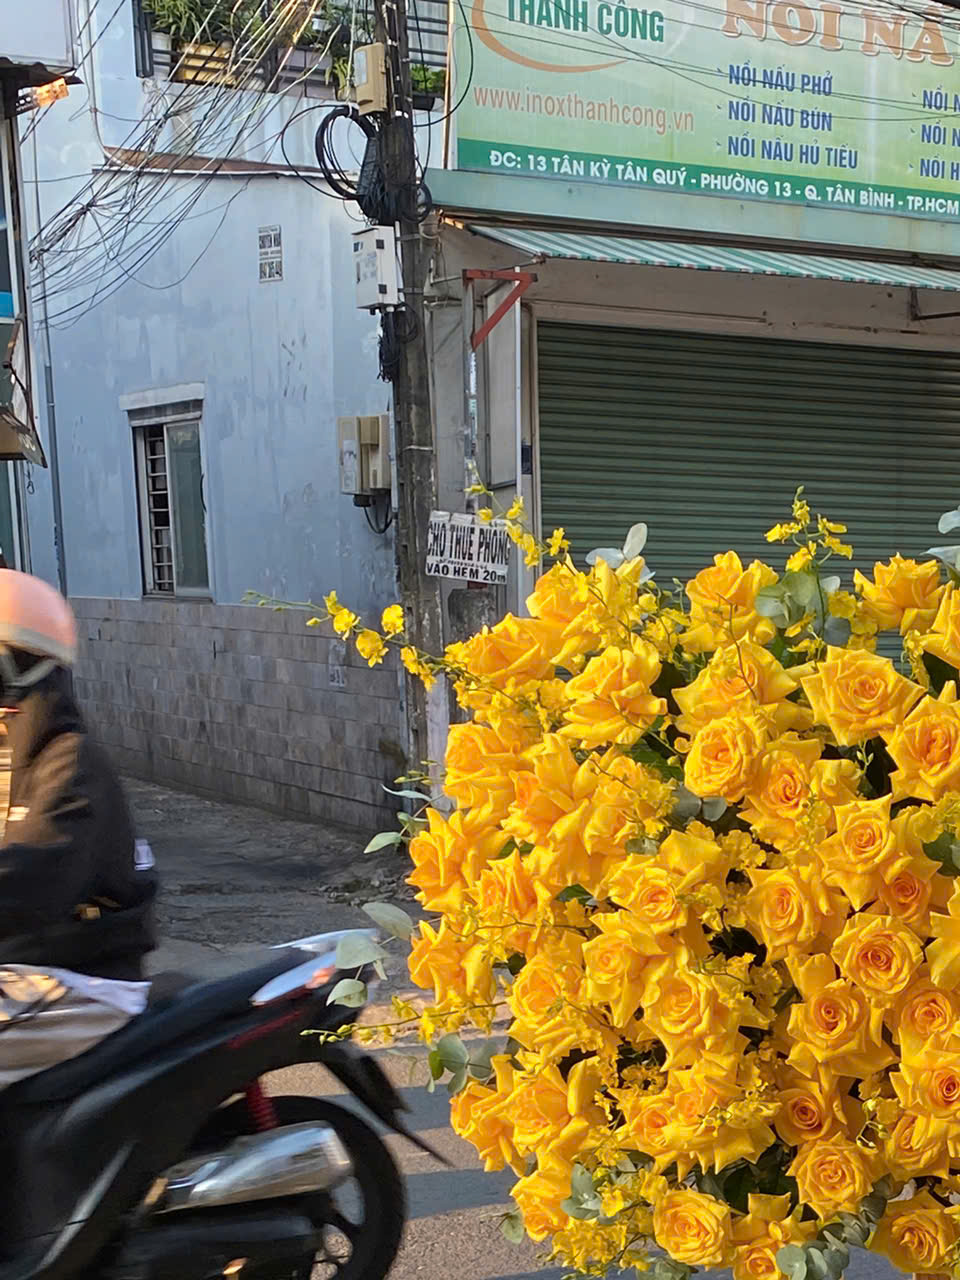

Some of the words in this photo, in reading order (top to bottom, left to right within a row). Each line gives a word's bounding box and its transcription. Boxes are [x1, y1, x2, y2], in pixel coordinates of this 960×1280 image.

[597, 1, 665, 42] CÔNG
[800, 70, 833, 96] PHỞ
[473, 85, 695, 135] www.inoxthanhcong.vn
[800, 107, 832, 131] BÚN
[799, 138, 820, 165] HỦ
[825, 143, 858, 169] TIẾU
[489, 150, 521, 168] ĐC:
[527, 154, 547, 172] 13
[551, 155, 584, 177] TÂN
[589, 158, 611, 178] KỲ
[616, 161, 648, 182] TÂN
[652, 167, 687, 187] QUÝ
[700, 173, 769, 196] PHƯỜNG
[774, 181, 792, 197] 13
[804, 185, 821, 201] Q.
[826, 184, 855, 204] TÂN
[859, 187, 895, 208] BÌNH
[906, 196, 960, 215] TP.HCM
[428, 521, 446, 557] CHO
